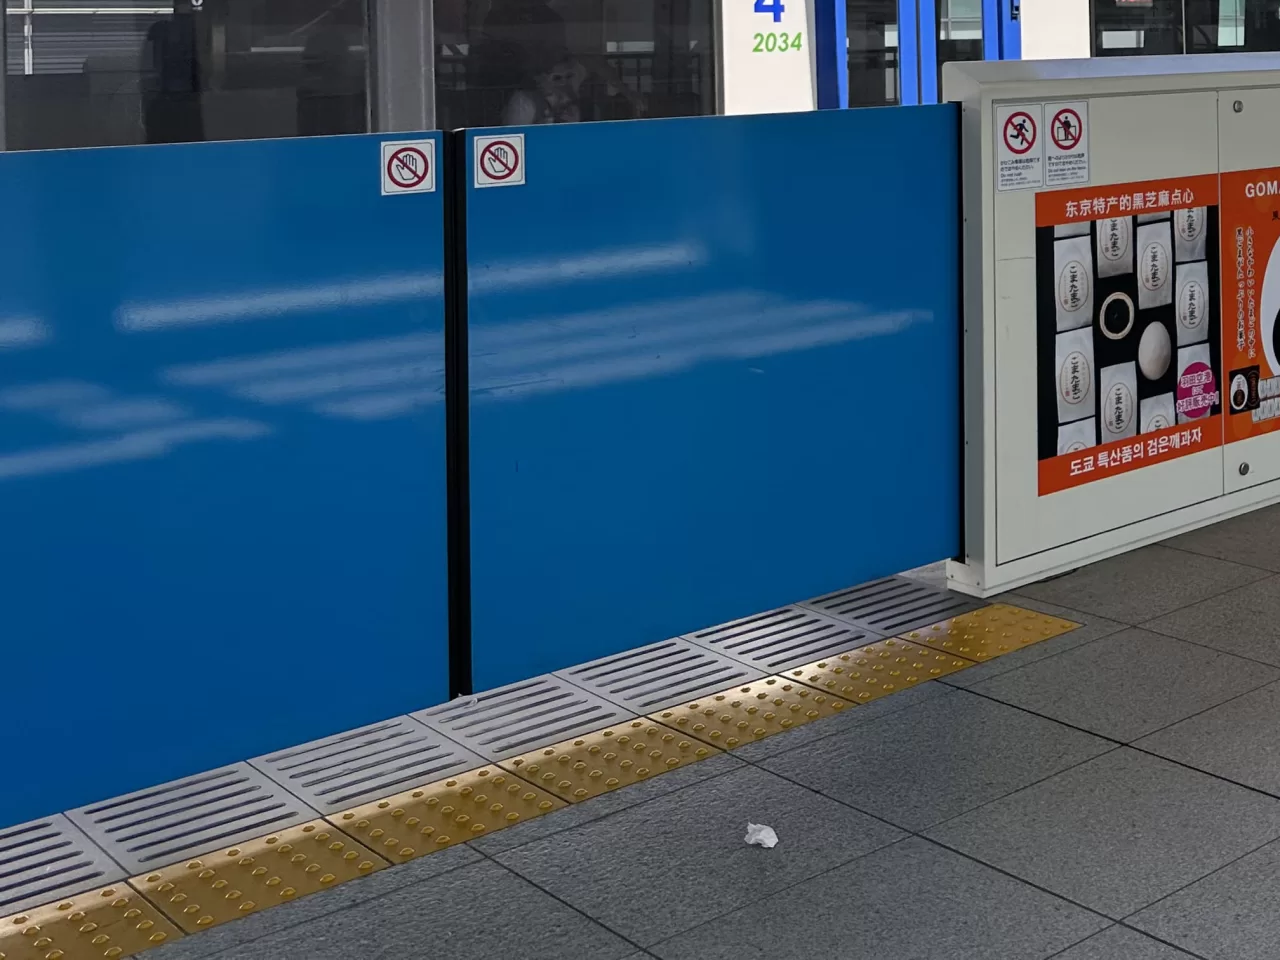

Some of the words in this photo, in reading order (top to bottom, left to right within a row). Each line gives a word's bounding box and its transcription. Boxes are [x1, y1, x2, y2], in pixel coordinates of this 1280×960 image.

[752, 32, 802, 52] 2034
[1065, 187, 1194, 218] 东京特产的黑芝麻点心
[1069, 456, 1095, 477] 도쿄
[1097, 441, 1144, 468] 특산품의
[1147, 427, 1202, 456] 검은깨과자
